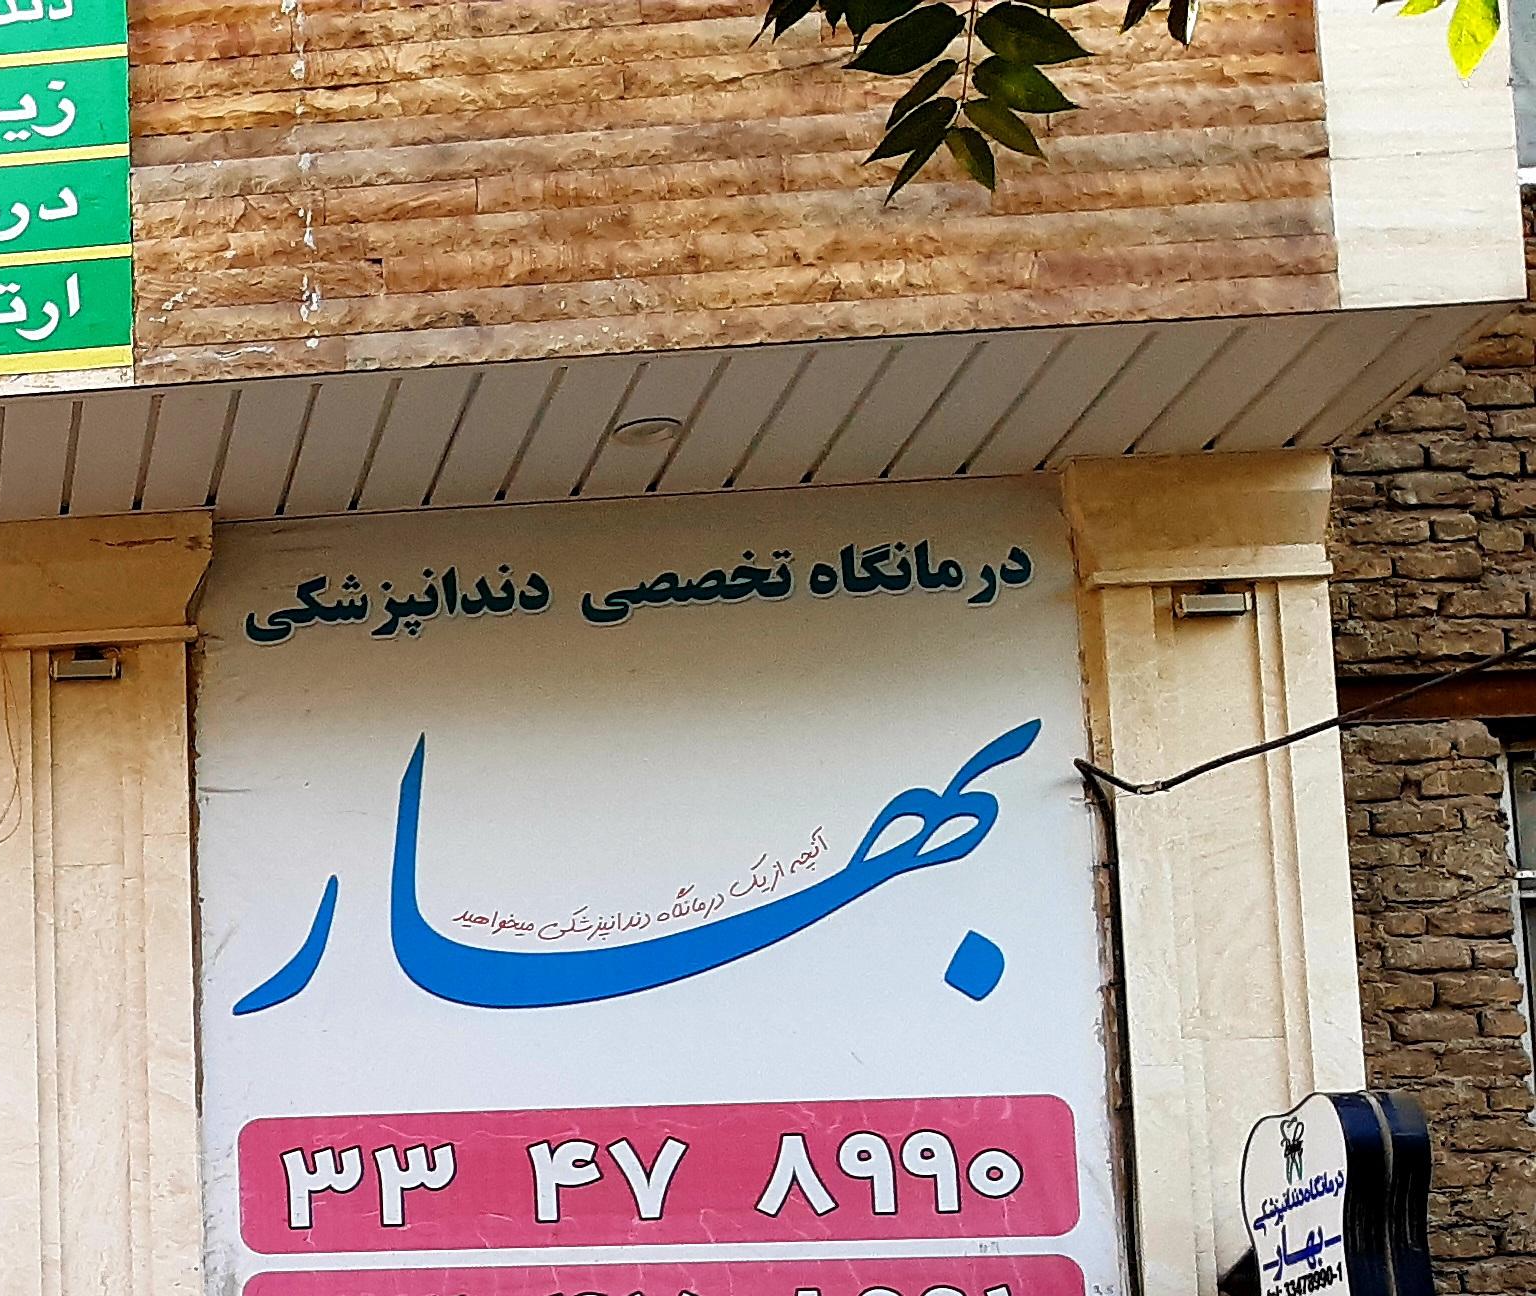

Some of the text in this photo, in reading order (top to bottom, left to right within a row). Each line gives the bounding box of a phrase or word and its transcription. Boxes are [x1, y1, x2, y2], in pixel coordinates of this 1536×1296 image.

[244, 541, 1034, 645] درمانگاه تخصصی دندانپزشکی
[232, 718, 1042, 1016] بهار
[538, 906, 651, 941] دندانپزشکی
